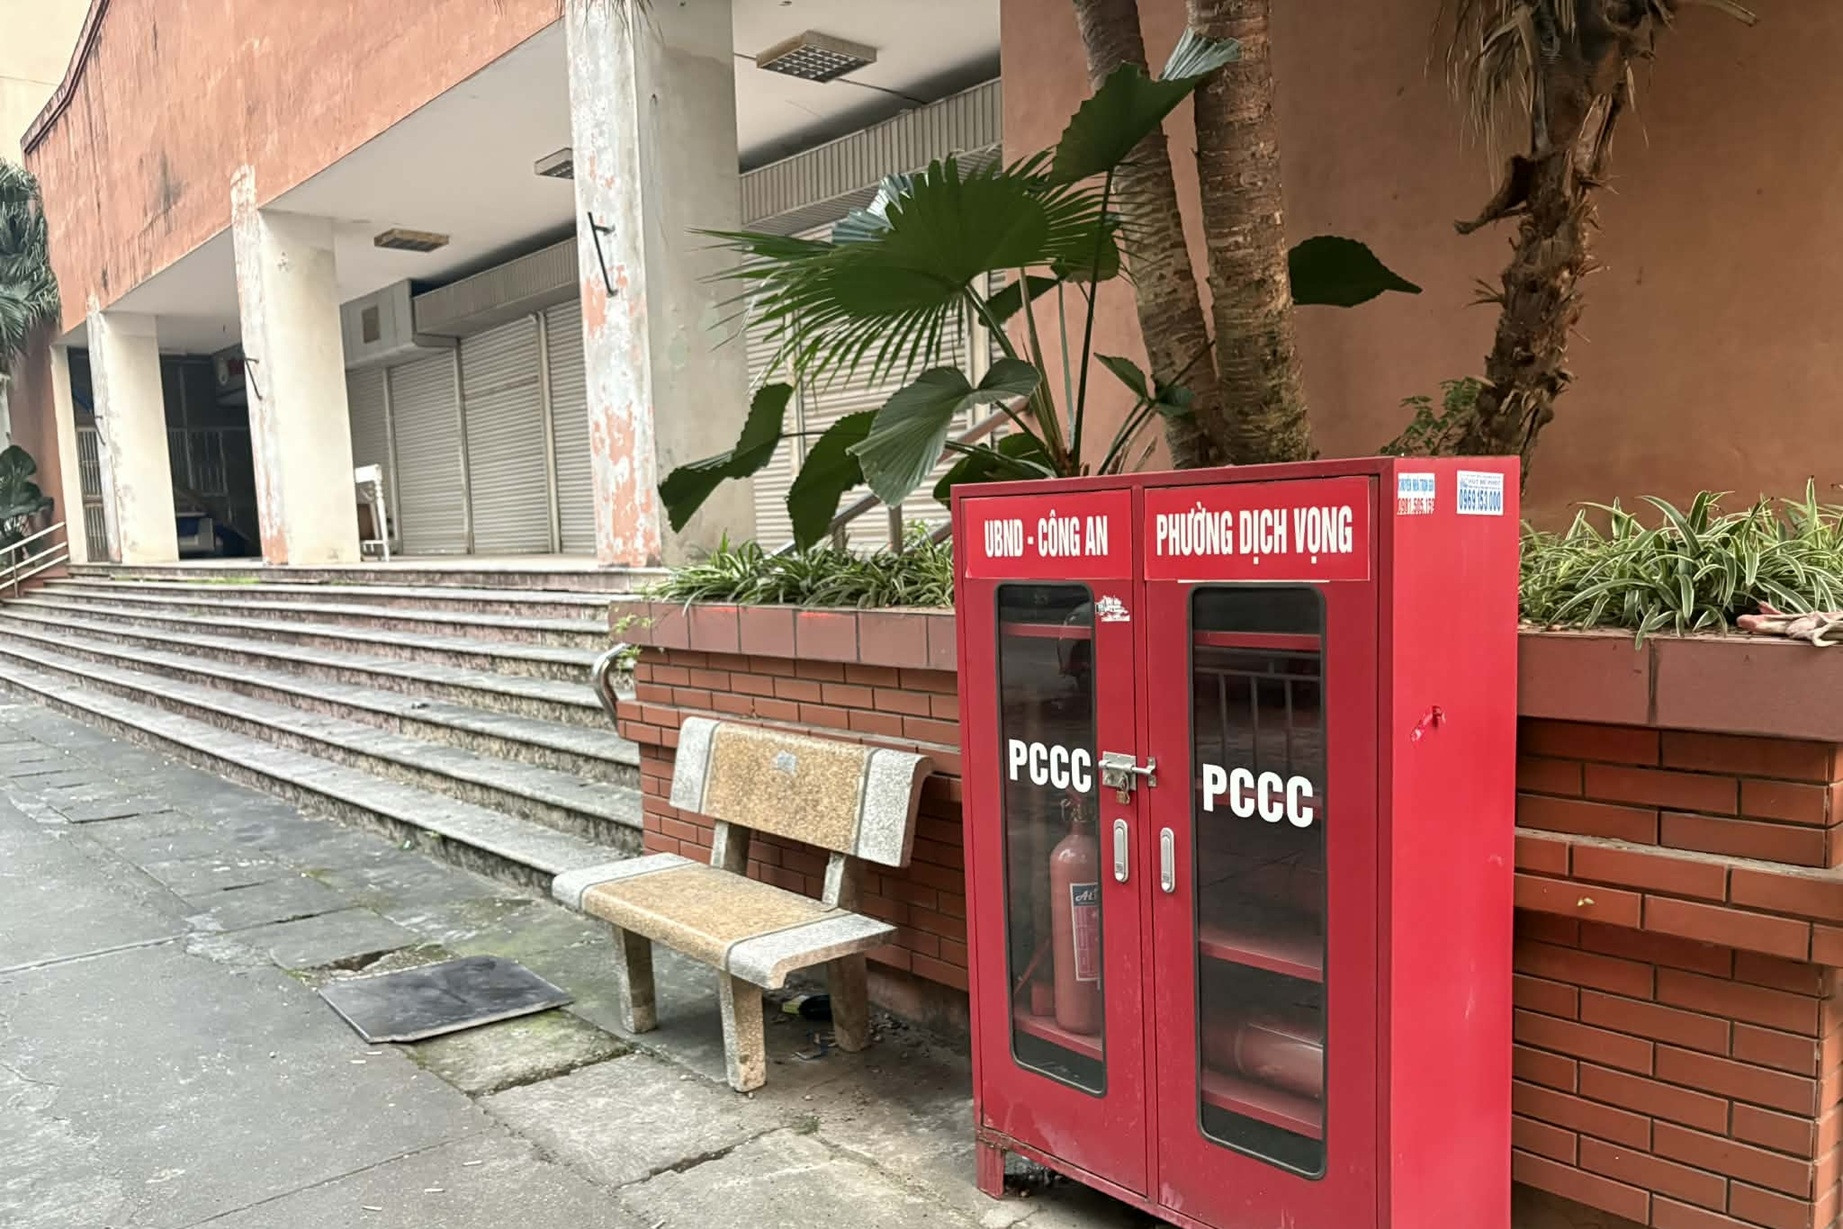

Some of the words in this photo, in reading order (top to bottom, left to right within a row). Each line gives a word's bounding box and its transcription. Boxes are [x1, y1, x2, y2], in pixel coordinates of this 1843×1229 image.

[984, 519, 1023, 558] UBND
[1038, 509, 1080, 557] CÔNG
[1084, 515, 1109, 556] AN
[1156, 501, 1232, 556] PHƯỜNG
[1239, 507, 1287, 565] DỊCH
[1294, 505, 1353, 564] VỌNG
[1009, 738, 1092, 793] PCCC
[1202, 763, 1314, 829] PCCC
